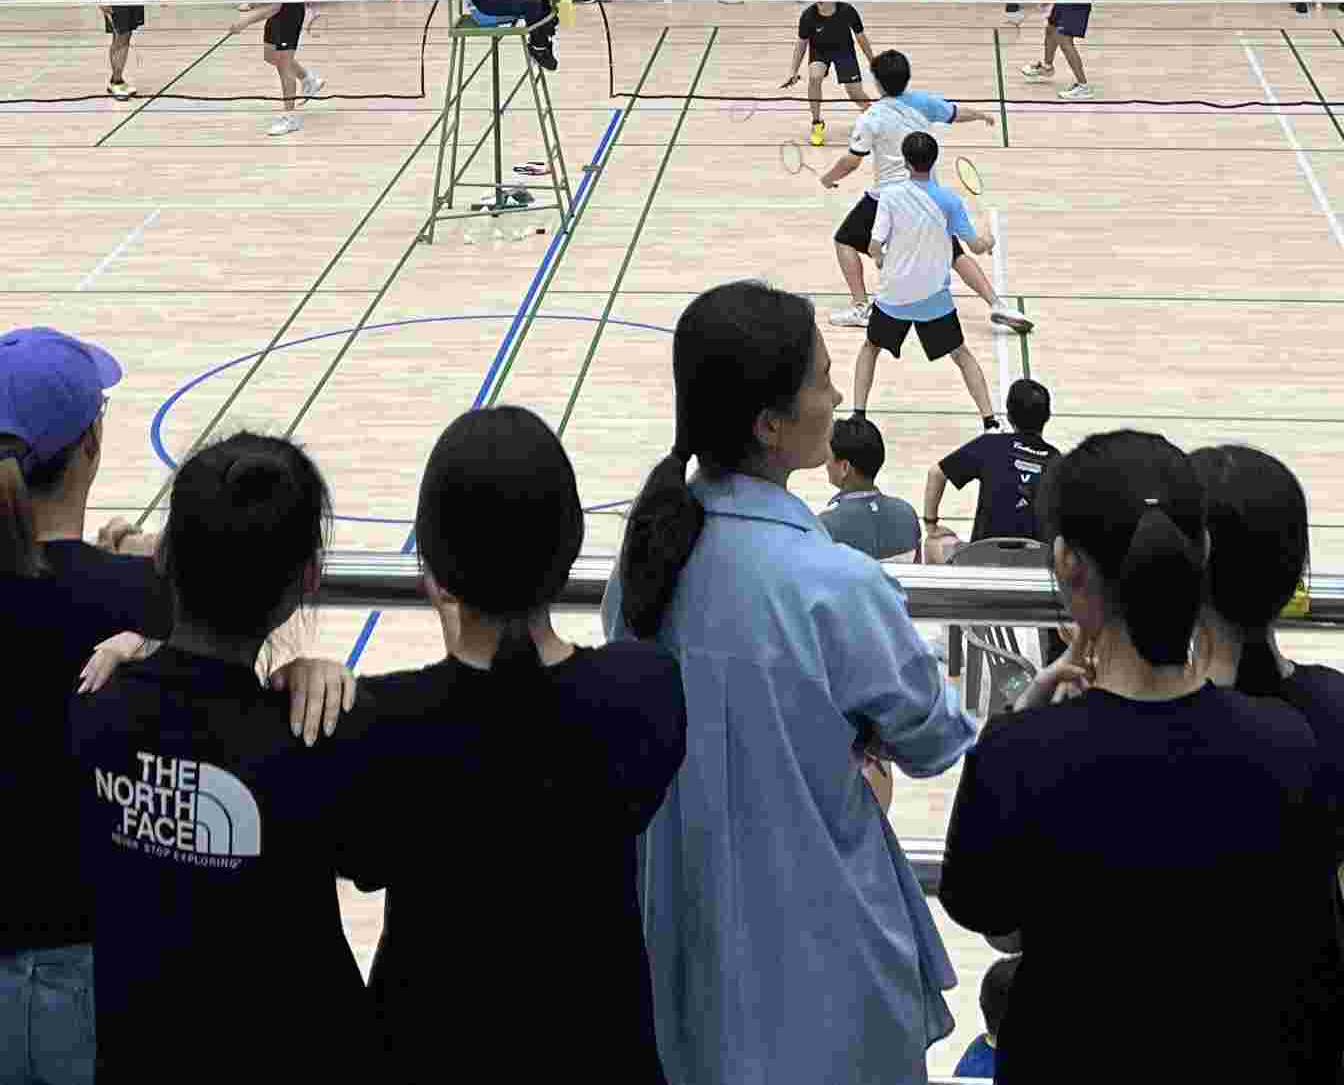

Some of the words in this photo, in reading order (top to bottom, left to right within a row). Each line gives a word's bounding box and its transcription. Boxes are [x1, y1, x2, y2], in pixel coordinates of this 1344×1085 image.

[94, 765, 197, 821] NORTH
[136, 750, 198, 792] THE
[122, 805, 195, 853] FACE
[173, 849, 241, 870] EXPLORING
